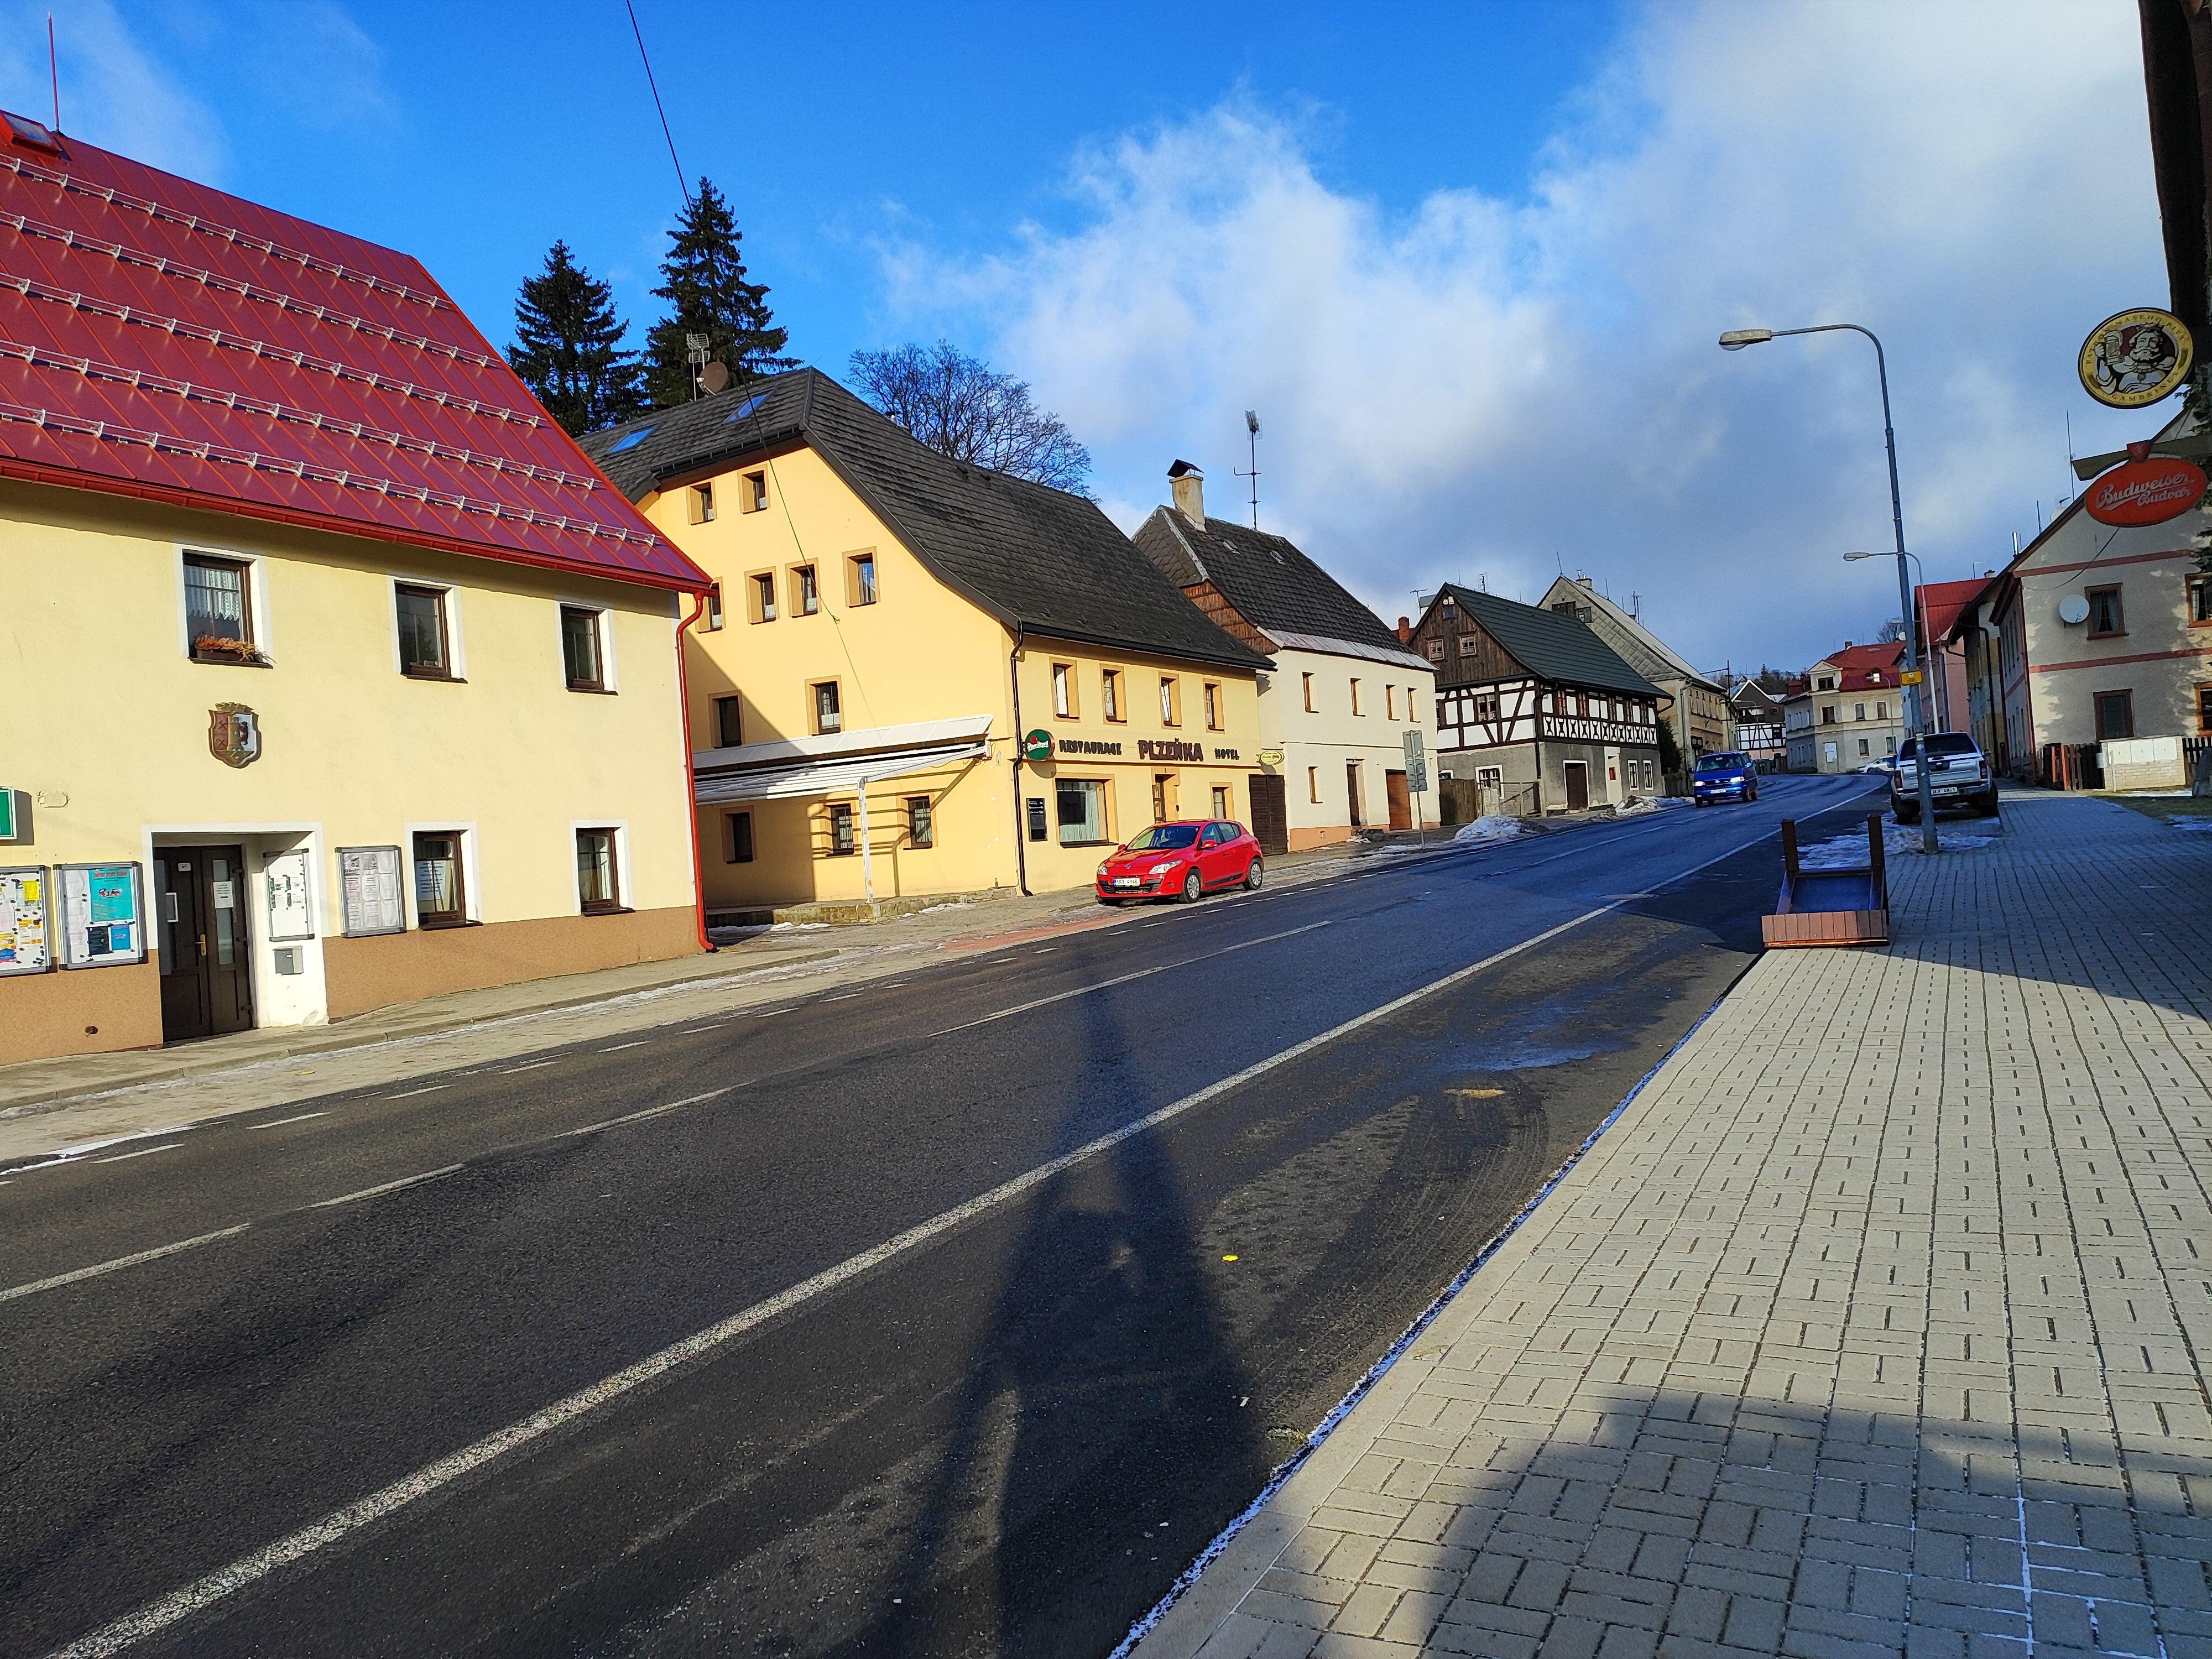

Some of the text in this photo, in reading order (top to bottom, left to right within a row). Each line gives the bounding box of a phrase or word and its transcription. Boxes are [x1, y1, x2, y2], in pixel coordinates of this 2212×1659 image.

[2111, 371, 2179, 401] GAMBRINUS
[2095, 472, 2194, 510] Budweiser
[2137, 487, 2194, 507] Budvar
[1058, 737, 1240, 762] RESTAURACE PLZEŇKA HOTEL
